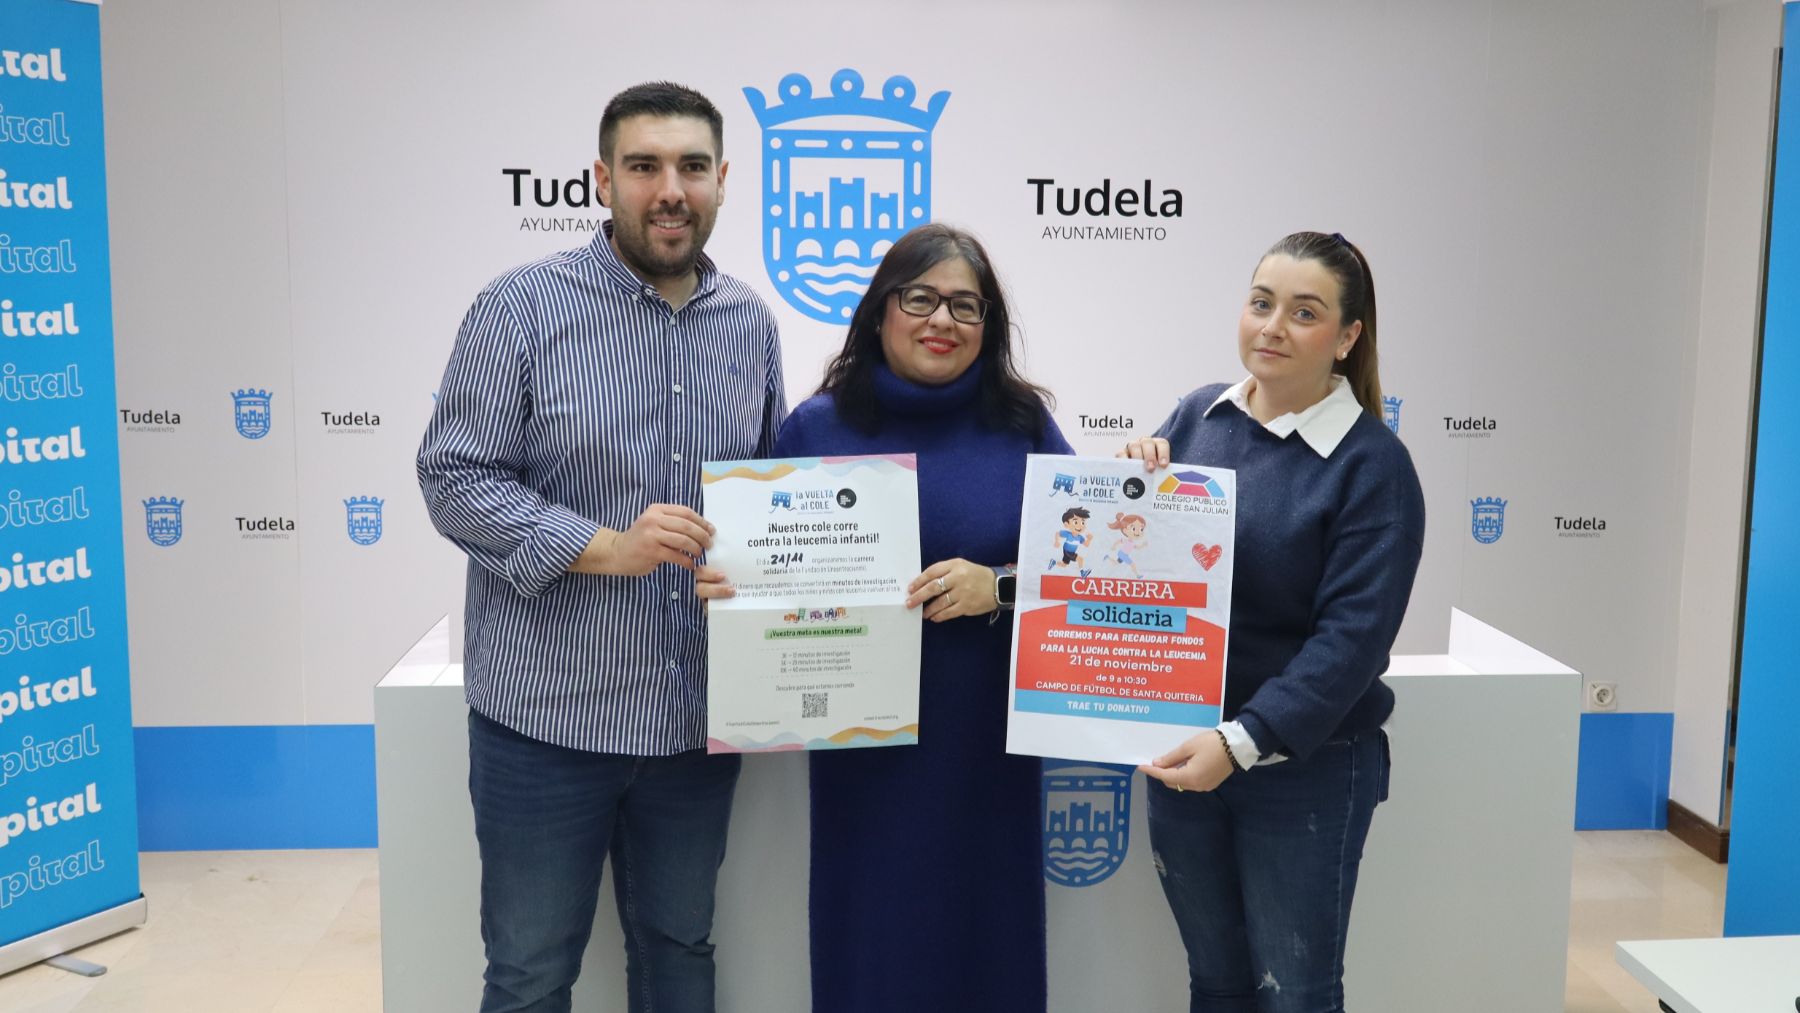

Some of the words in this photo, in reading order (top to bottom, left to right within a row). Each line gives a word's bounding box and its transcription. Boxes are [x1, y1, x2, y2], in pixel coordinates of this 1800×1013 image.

[0, 48, 67, 81] tal
[502, 168, 604, 208] Tud
[1027, 178, 1183, 217] Tudela
[1042, 226, 1167, 241] AYUNTAMIENTO
[1, 299, 79, 337] ital
[0, 362, 83, 402] ital
[120, 409, 180, 424] Tudela
[320, 411, 380, 426] Tudela
[1079, 414, 1133, 429] Tudela
[1443, 416, 1496, 430] Tudela
[0, 426, 86, 464] ital
[1080, 475, 1088, 485] la
[1090, 475, 1120, 487] VUELTA
[796, 490, 804, 499] la
[805, 489, 834, 499] VUELTA
[1083, 488, 1091, 497] al
[1093, 488, 1115, 498] COLE
[1155, 494, 1191, 504] COLEGIO
[800, 501, 808, 510] al
[809, 501, 830, 510] COLE
[1153, 502, 1182, 512] MONTE
[1184, 505, 1200, 513] SAN
[235, 516, 295, 531] Tudela
[768, 522, 810, 534] ¡Nuestro
[811, 521, 831, 532] cole
[833, 522, 859, 532] corre
[1554, 516, 1606, 530] Tudela
[747, 536, 780, 547] contra
[782, 535, 792, 546] la
[794, 534, 838, 546] leucemia
[840, 532, 880, 544] infantil!
[771, 552, 803, 568] 21/11
[763, 567, 788, 576] solidaria
[1071, 578, 1175, 600] CARRERA
[1081, 605, 1173, 628] solidaria
[820, 627, 844, 636] nuestra
[844, 626, 862, 634] meta!
[1047, 629, 1093, 640] CORREMOS
[1095, 632, 1120, 642] PARA
[1121, 633, 1168, 645] RECAUDAR
[1170, 636, 1205, 646] FONDOS
[1040, 643, 1064, 652] PARA
[1066, 645, 1078, 653] LA
[1081, 646, 1110, 656] LUCHA
[1112, 647, 1147, 658] CONTRA
[1150, 649, 1161, 658] LA
[1163, 650, 1207, 661] LEUCEMIA
[1069, 655, 1082, 665] 21
[1085, 656, 1101, 667] de
[1104, 659, 1173, 673] noviembre
[1096, 674, 1107, 682] de
[1109, 675, 1115, 683] 9
[1124, 676, 1148, 685] 10:30
[1036, 680, 1069, 691] CAMPO
[1070, 683, 1081, 692] DE
[1083, 683, 1117, 695] FÚTBOL
[1119, 688, 1130, 696] DE
[1132, 689, 1162, 699] SANTA
[1164, 691, 1204, 702] QUITERIA
[1067, 701, 1090, 711] TRAE
[1093, 702, 1105, 711] TU
[1108, 703, 1150, 714] DONATIVO
[0, 723, 100, 786] pital
[0, 782, 102, 848] pital
[0, 839, 105, 908] pital
